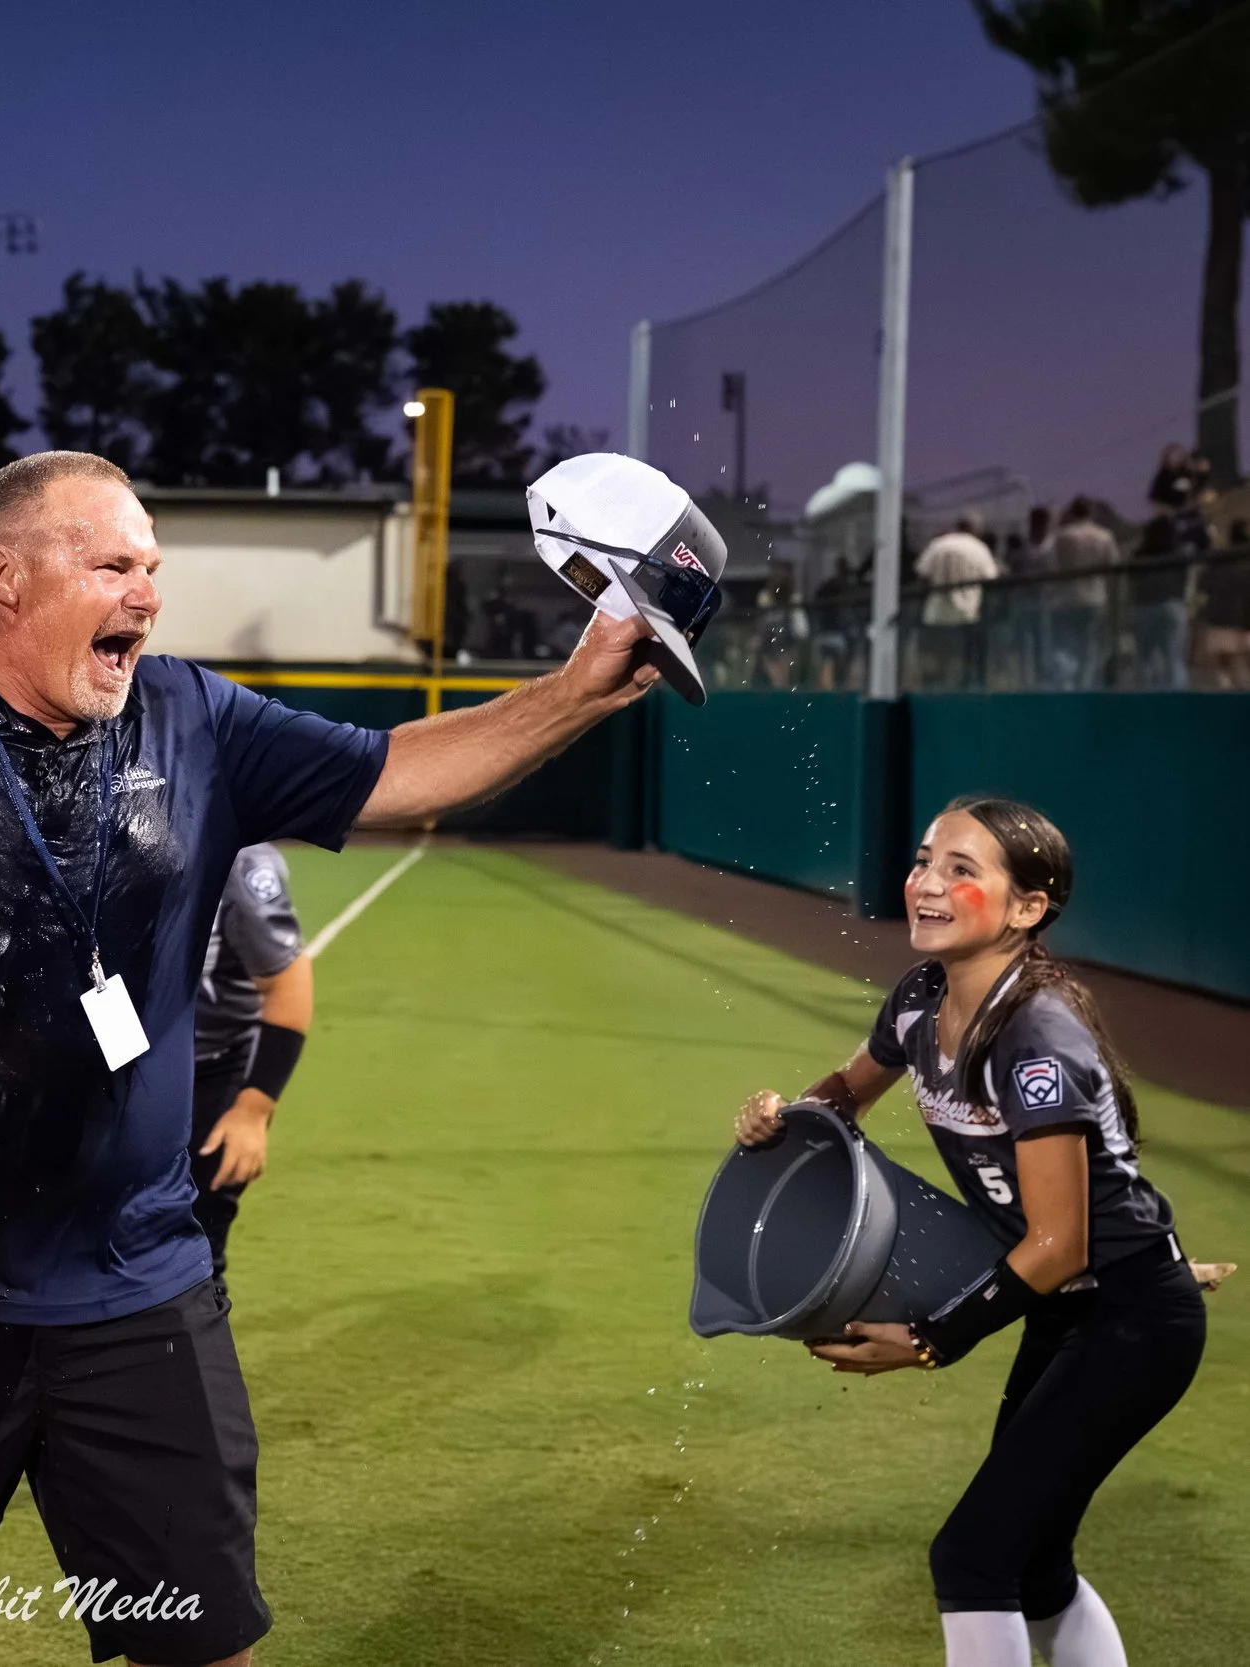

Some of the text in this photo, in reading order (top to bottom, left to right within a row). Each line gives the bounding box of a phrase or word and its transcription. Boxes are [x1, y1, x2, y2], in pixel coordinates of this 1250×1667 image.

[124, 767, 152, 781] Little
[128, 777, 166, 790] League
[977, 1167, 1013, 1204] 5
